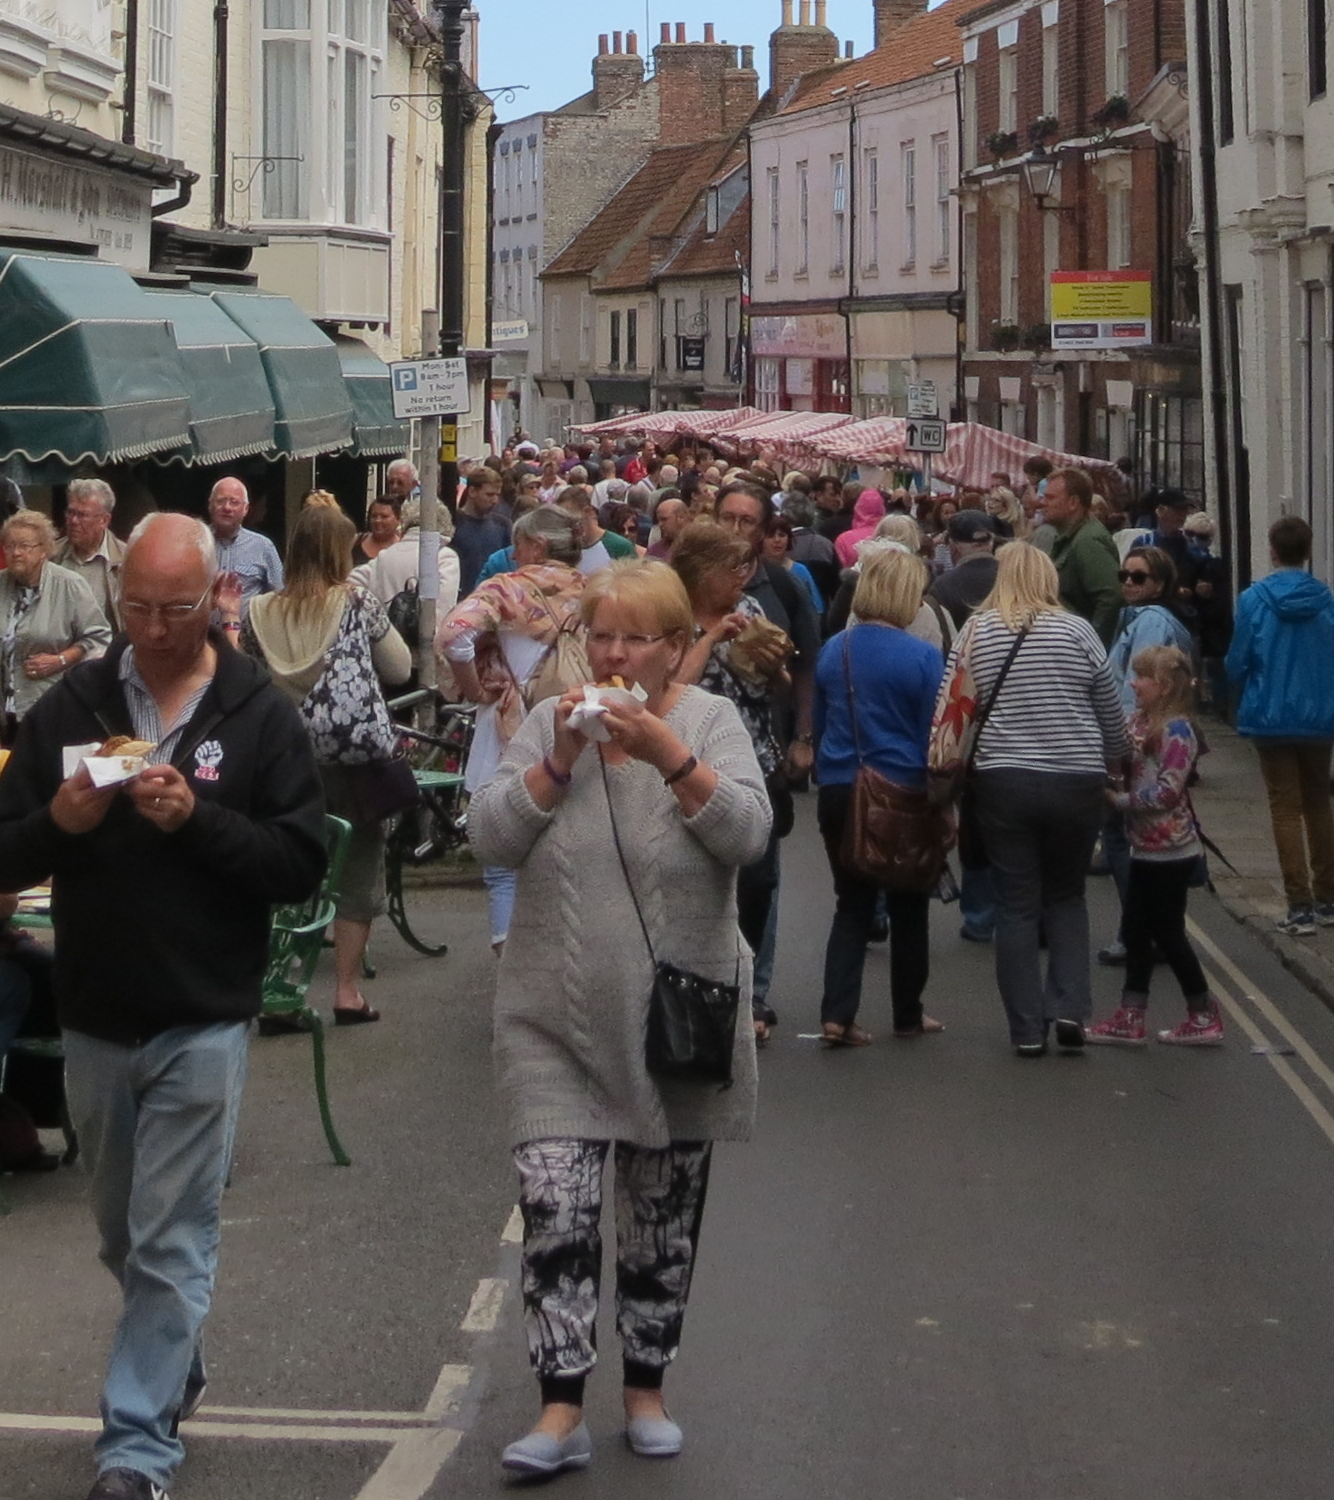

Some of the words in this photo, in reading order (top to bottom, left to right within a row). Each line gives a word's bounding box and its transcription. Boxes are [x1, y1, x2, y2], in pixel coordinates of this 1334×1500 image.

[399, 370, 415, 389] P
[411, 396, 424, 404] No
[425, 394, 452, 403] return
[405, 405, 432, 414] within
[924, 430, 940, 442] WC
